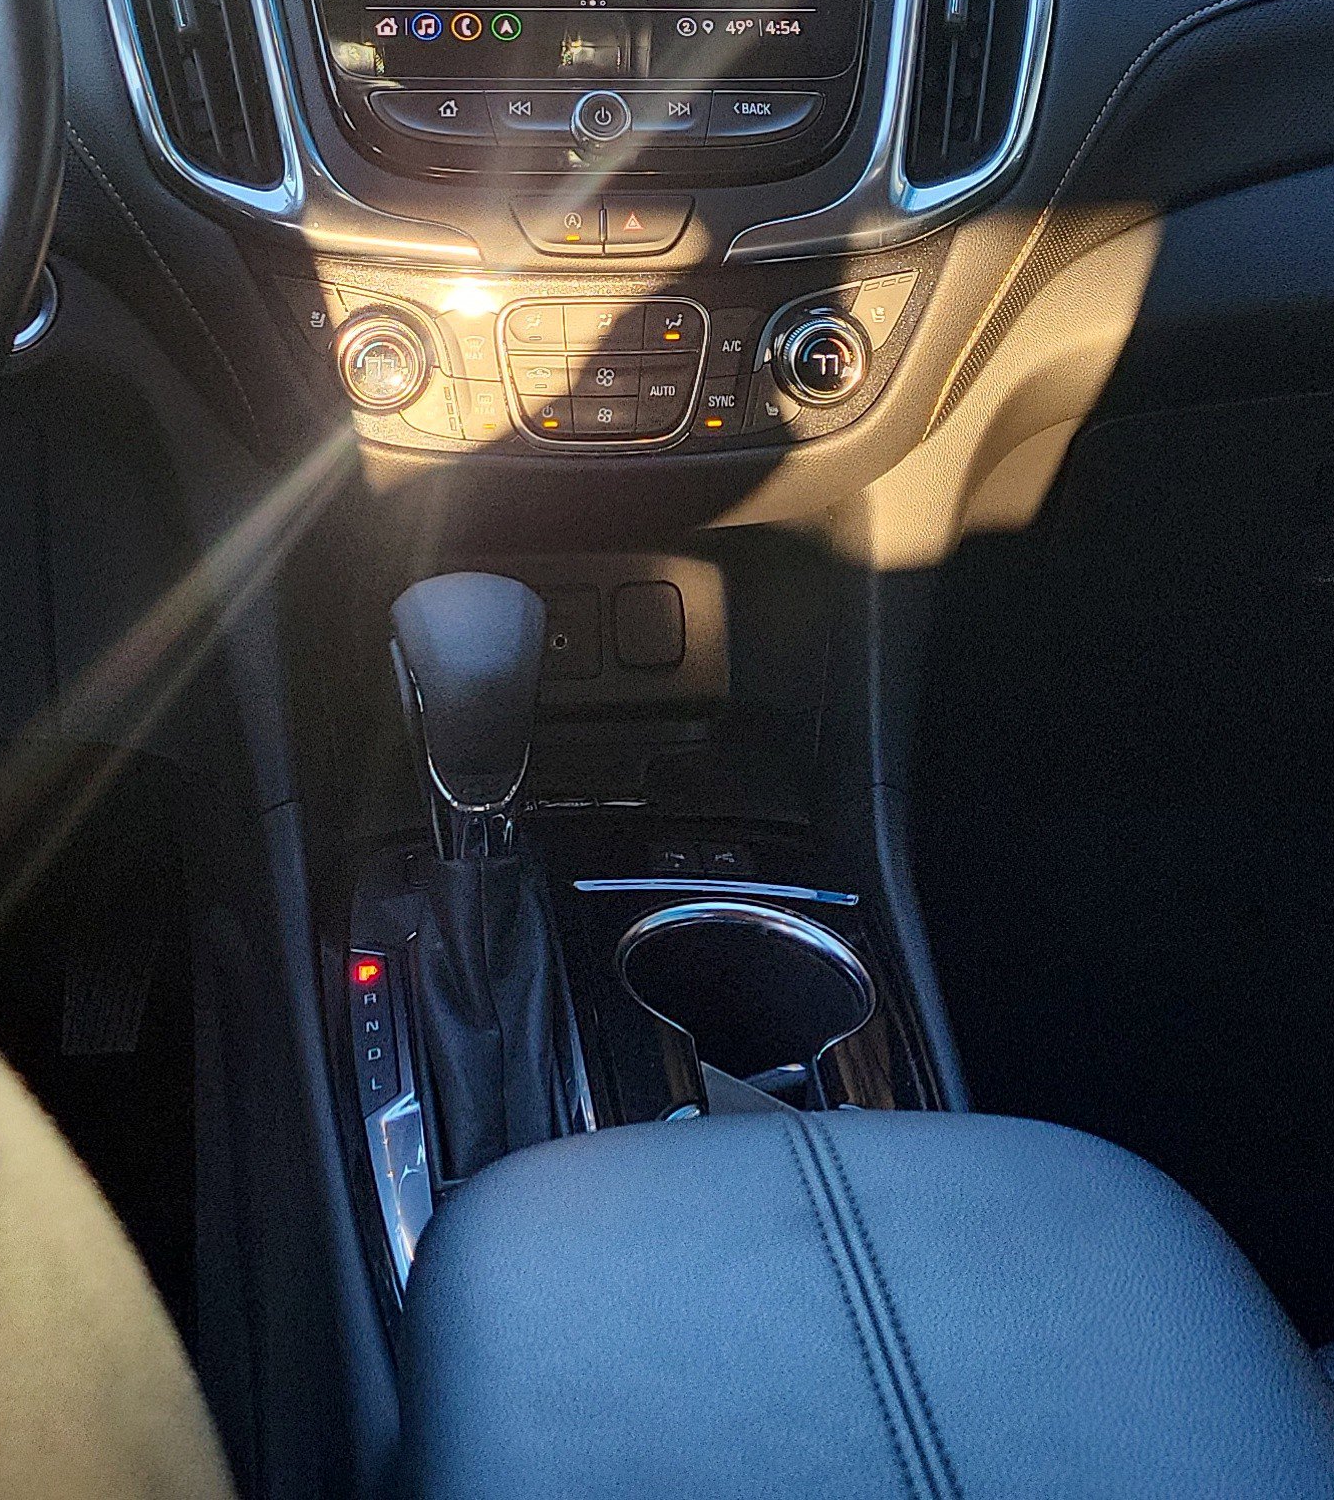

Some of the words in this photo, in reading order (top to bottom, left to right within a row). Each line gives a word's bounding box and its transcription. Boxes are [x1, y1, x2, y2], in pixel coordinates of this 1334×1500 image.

[725, 18, 754, 37] 49°
[765, 18, 801, 37] 4:54
[740, 101, 771, 117] BACK
[721, 337, 742, 354] A/C
[649, 384, 676, 398] AUTO
[707, 393, 736, 408] SYNC
[358, 965, 378, 981] P
[364, 993, 376, 1005] R
[366, 1020, 379, 1032] N
[368, 1048, 381, 1061] D
[371, 1077, 382, 1090] L
